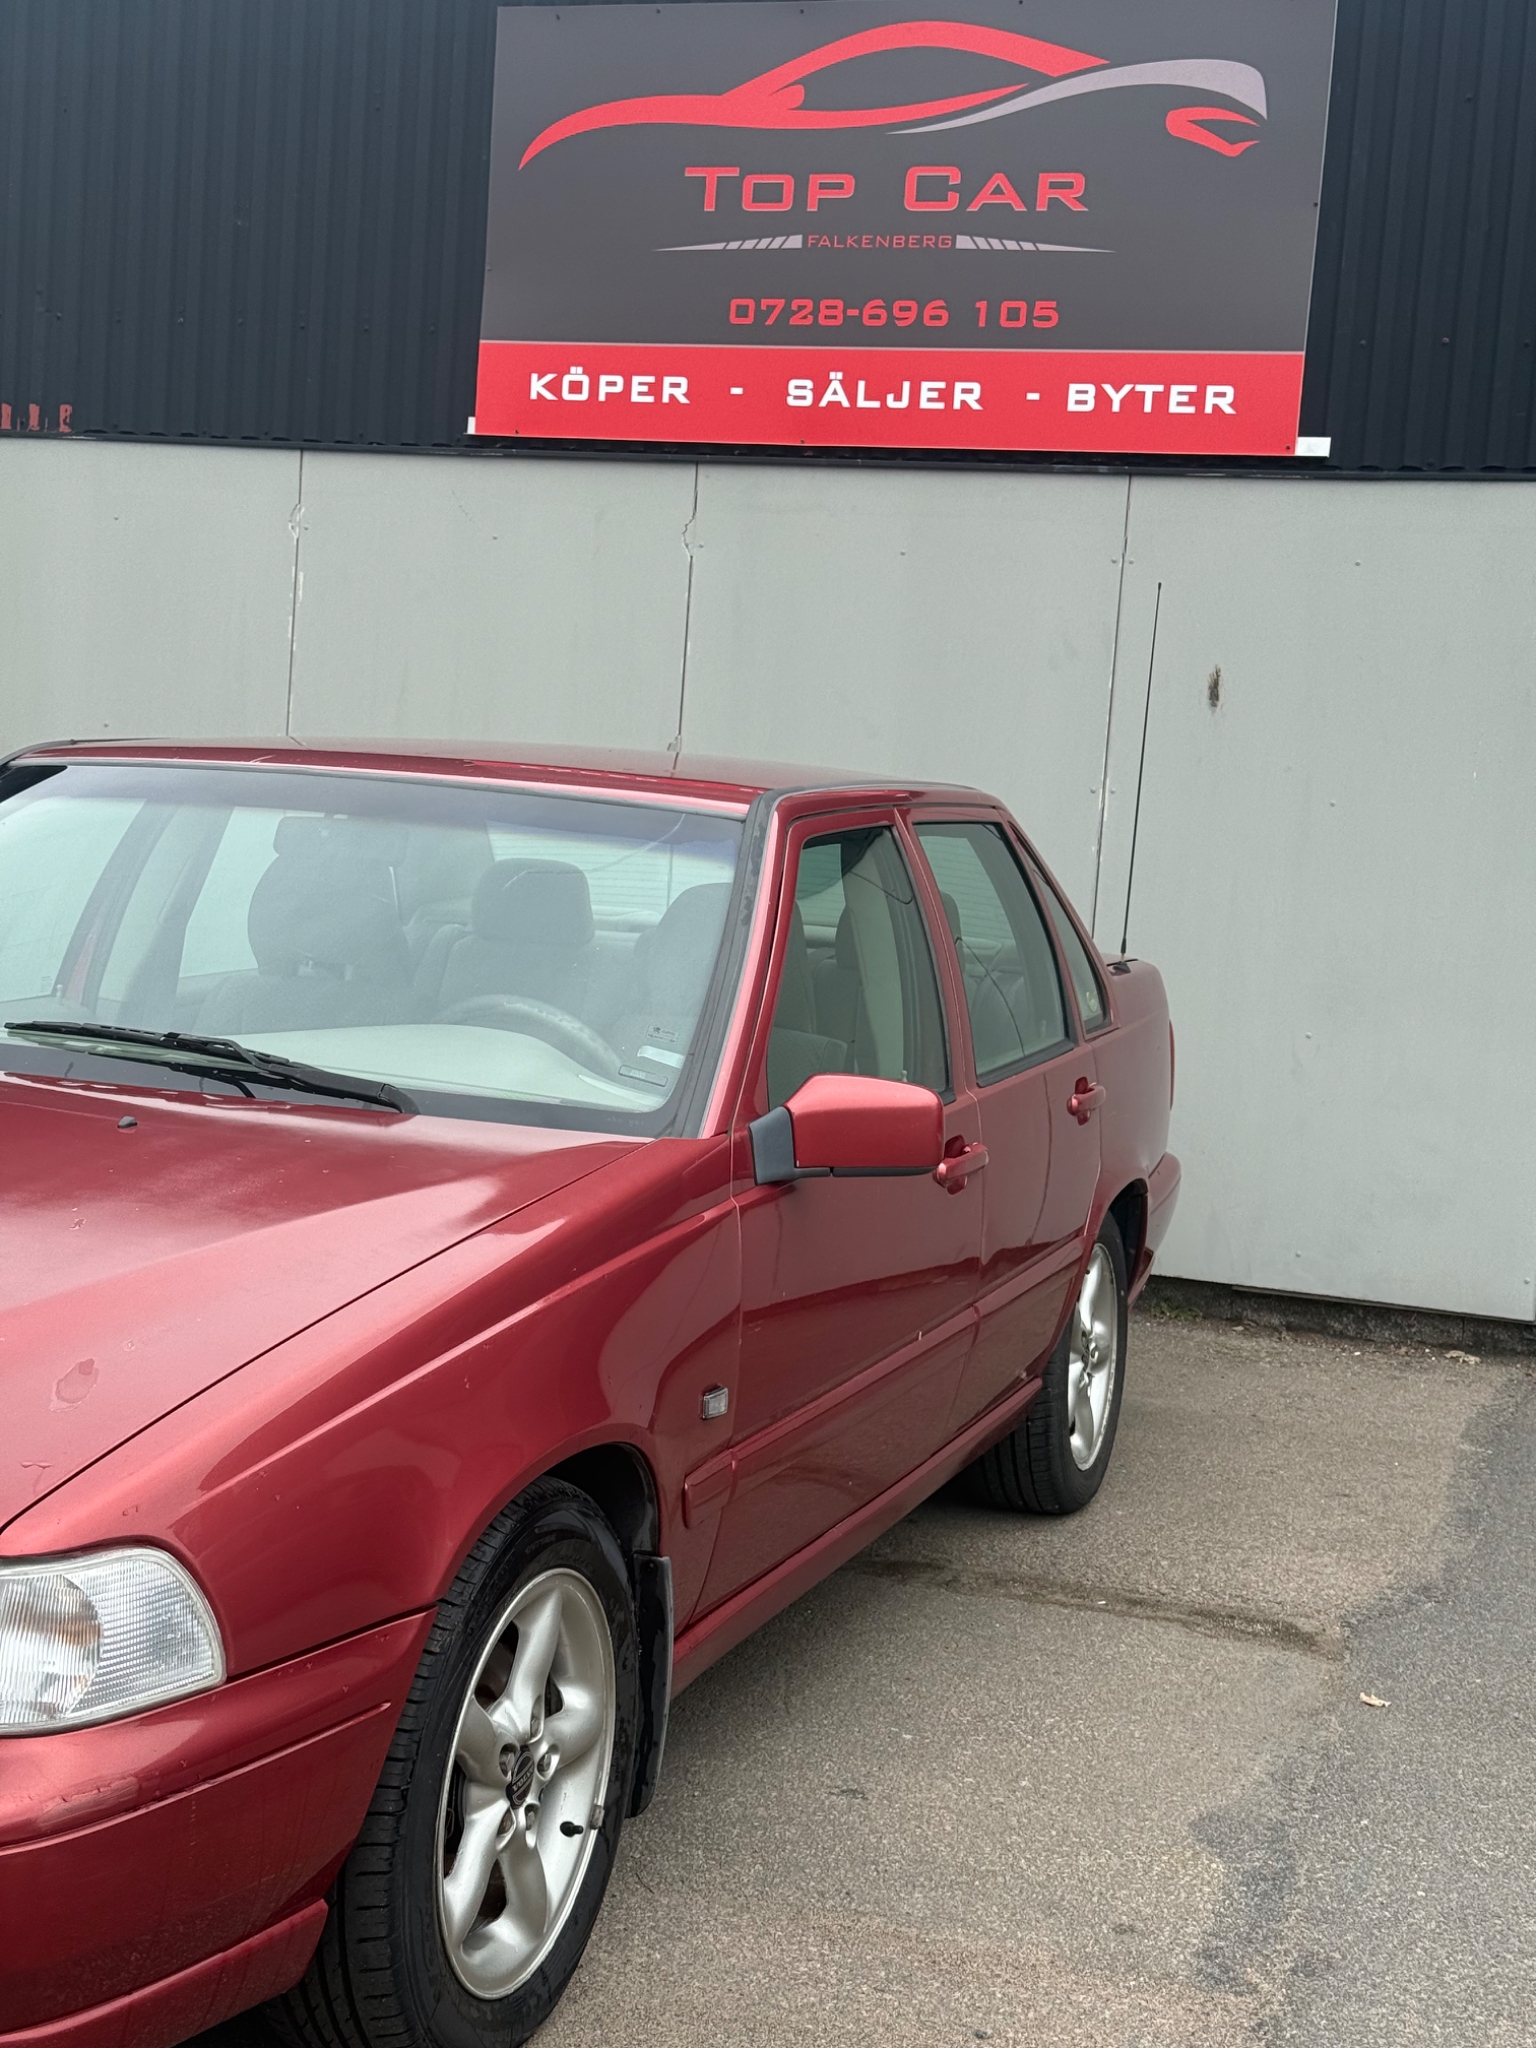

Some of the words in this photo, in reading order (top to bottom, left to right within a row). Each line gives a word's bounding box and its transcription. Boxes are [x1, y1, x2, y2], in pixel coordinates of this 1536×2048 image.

[684, 165, 857, 213] TOP
[903, 165, 1088, 214] CAR
[806, 233, 953, 250] FALKENBERG
[728, 297, 950, 328] 0728-696
[975, 299, 1060, 329] 105
[530, 366, 690, 404] KÖPER
[787, 372, 983, 410] SÄLJER
[1067, 383, 1237, 415] BYTER
